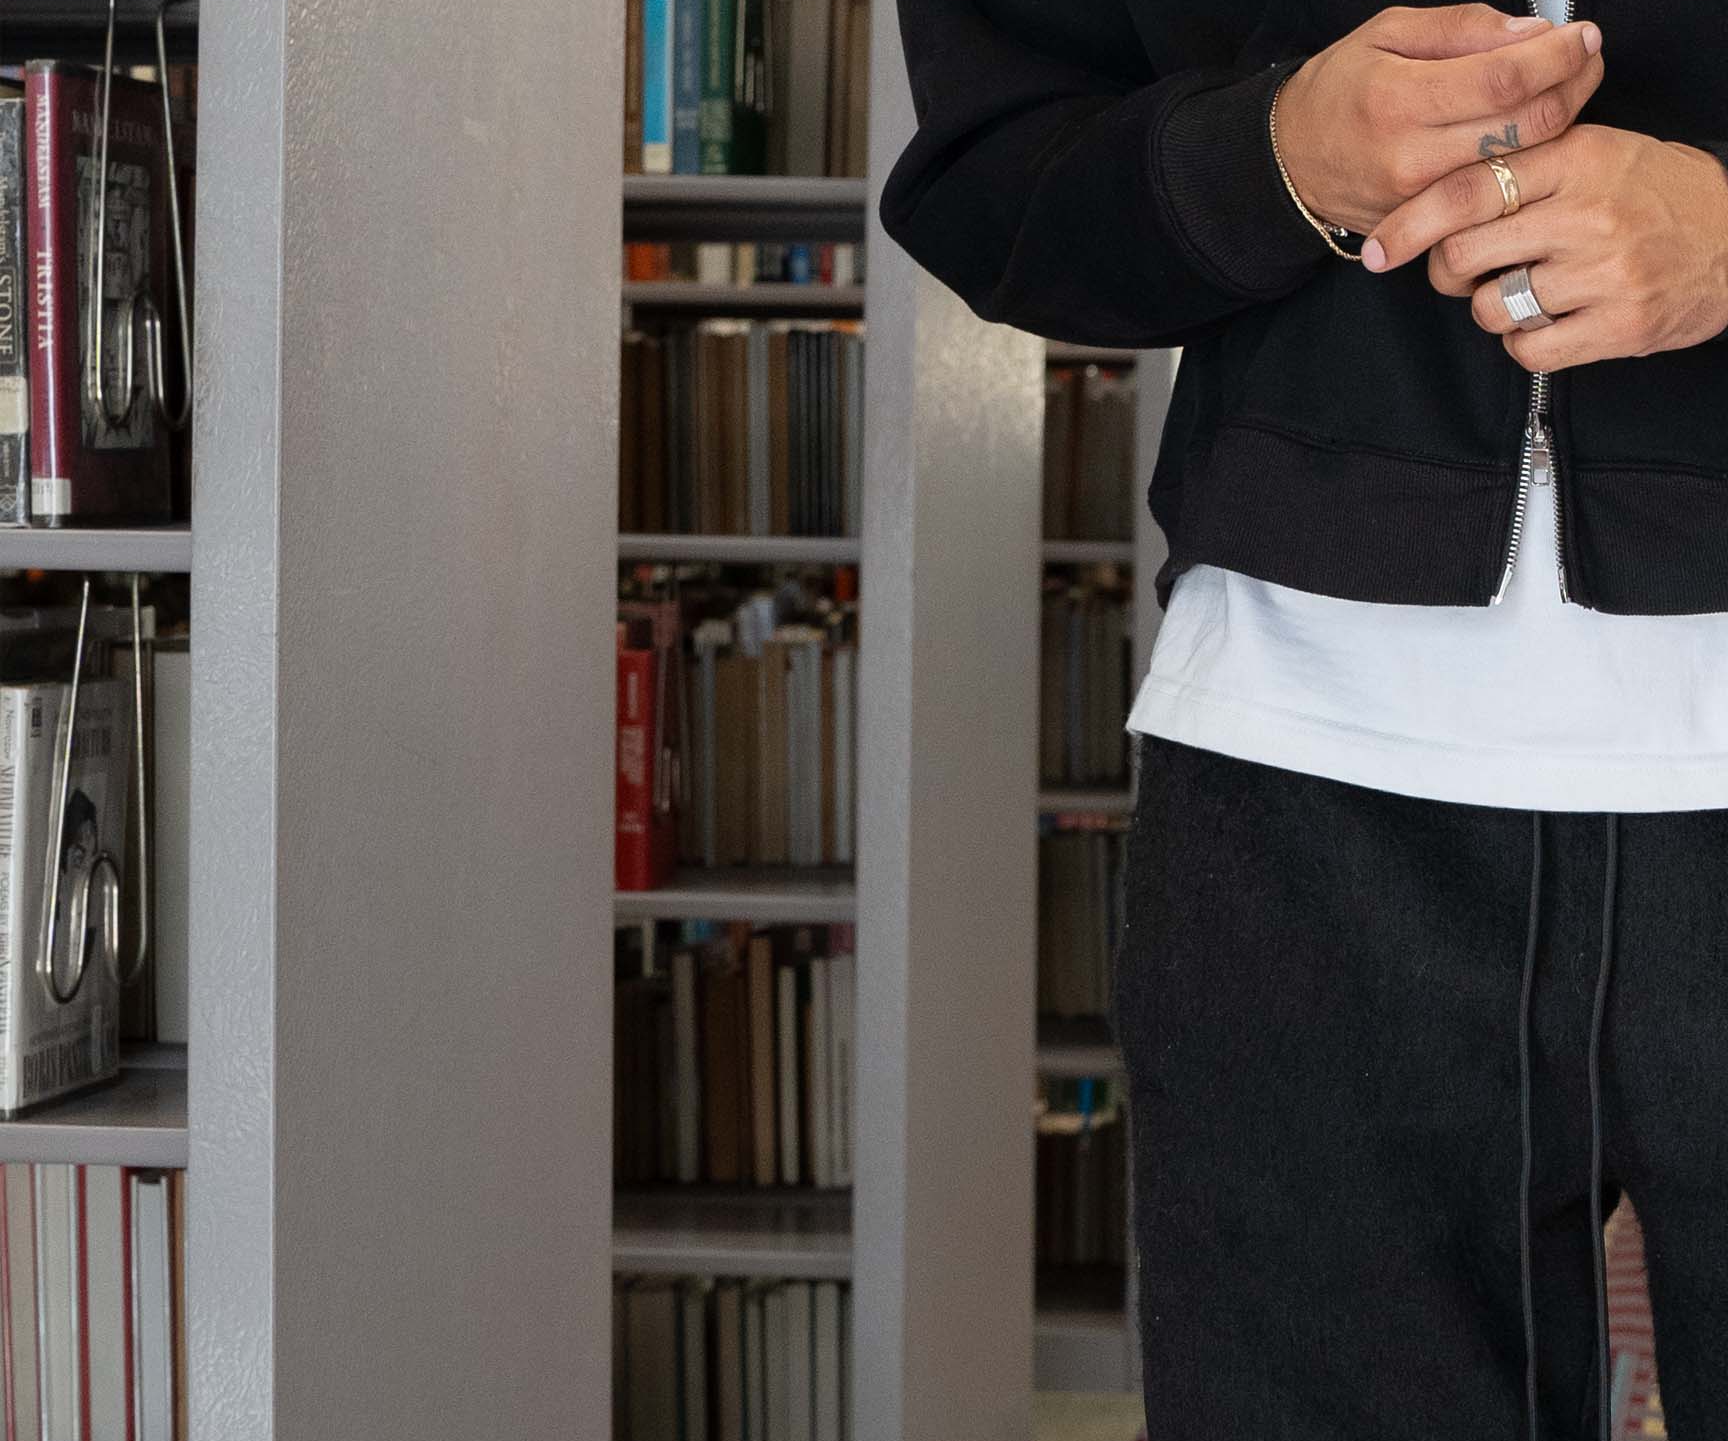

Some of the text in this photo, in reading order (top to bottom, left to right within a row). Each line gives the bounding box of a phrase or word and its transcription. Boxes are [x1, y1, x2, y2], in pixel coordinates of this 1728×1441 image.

[35, 94, 54, 350] MANDELSTAM TRISTIA
[0, 273, 13, 355] STONE
